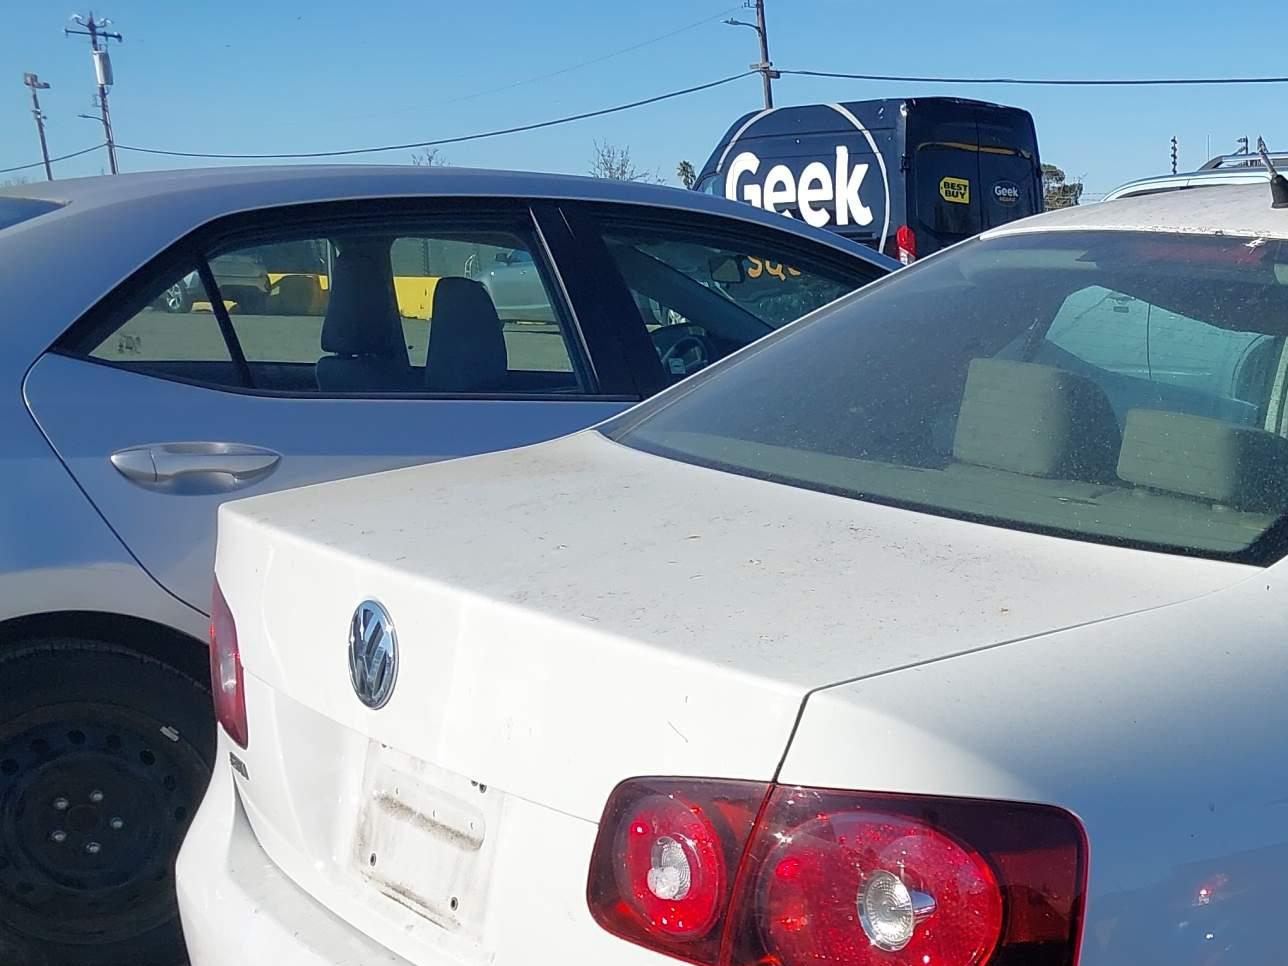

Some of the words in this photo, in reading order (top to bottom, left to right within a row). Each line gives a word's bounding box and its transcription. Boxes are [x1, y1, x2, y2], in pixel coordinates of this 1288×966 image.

[725, 145, 873, 228] Geek
[943, 182, 968, 191] BEST
[994, 185, 1019, 197] Geek
[945, 189, 966, 199] BUY
